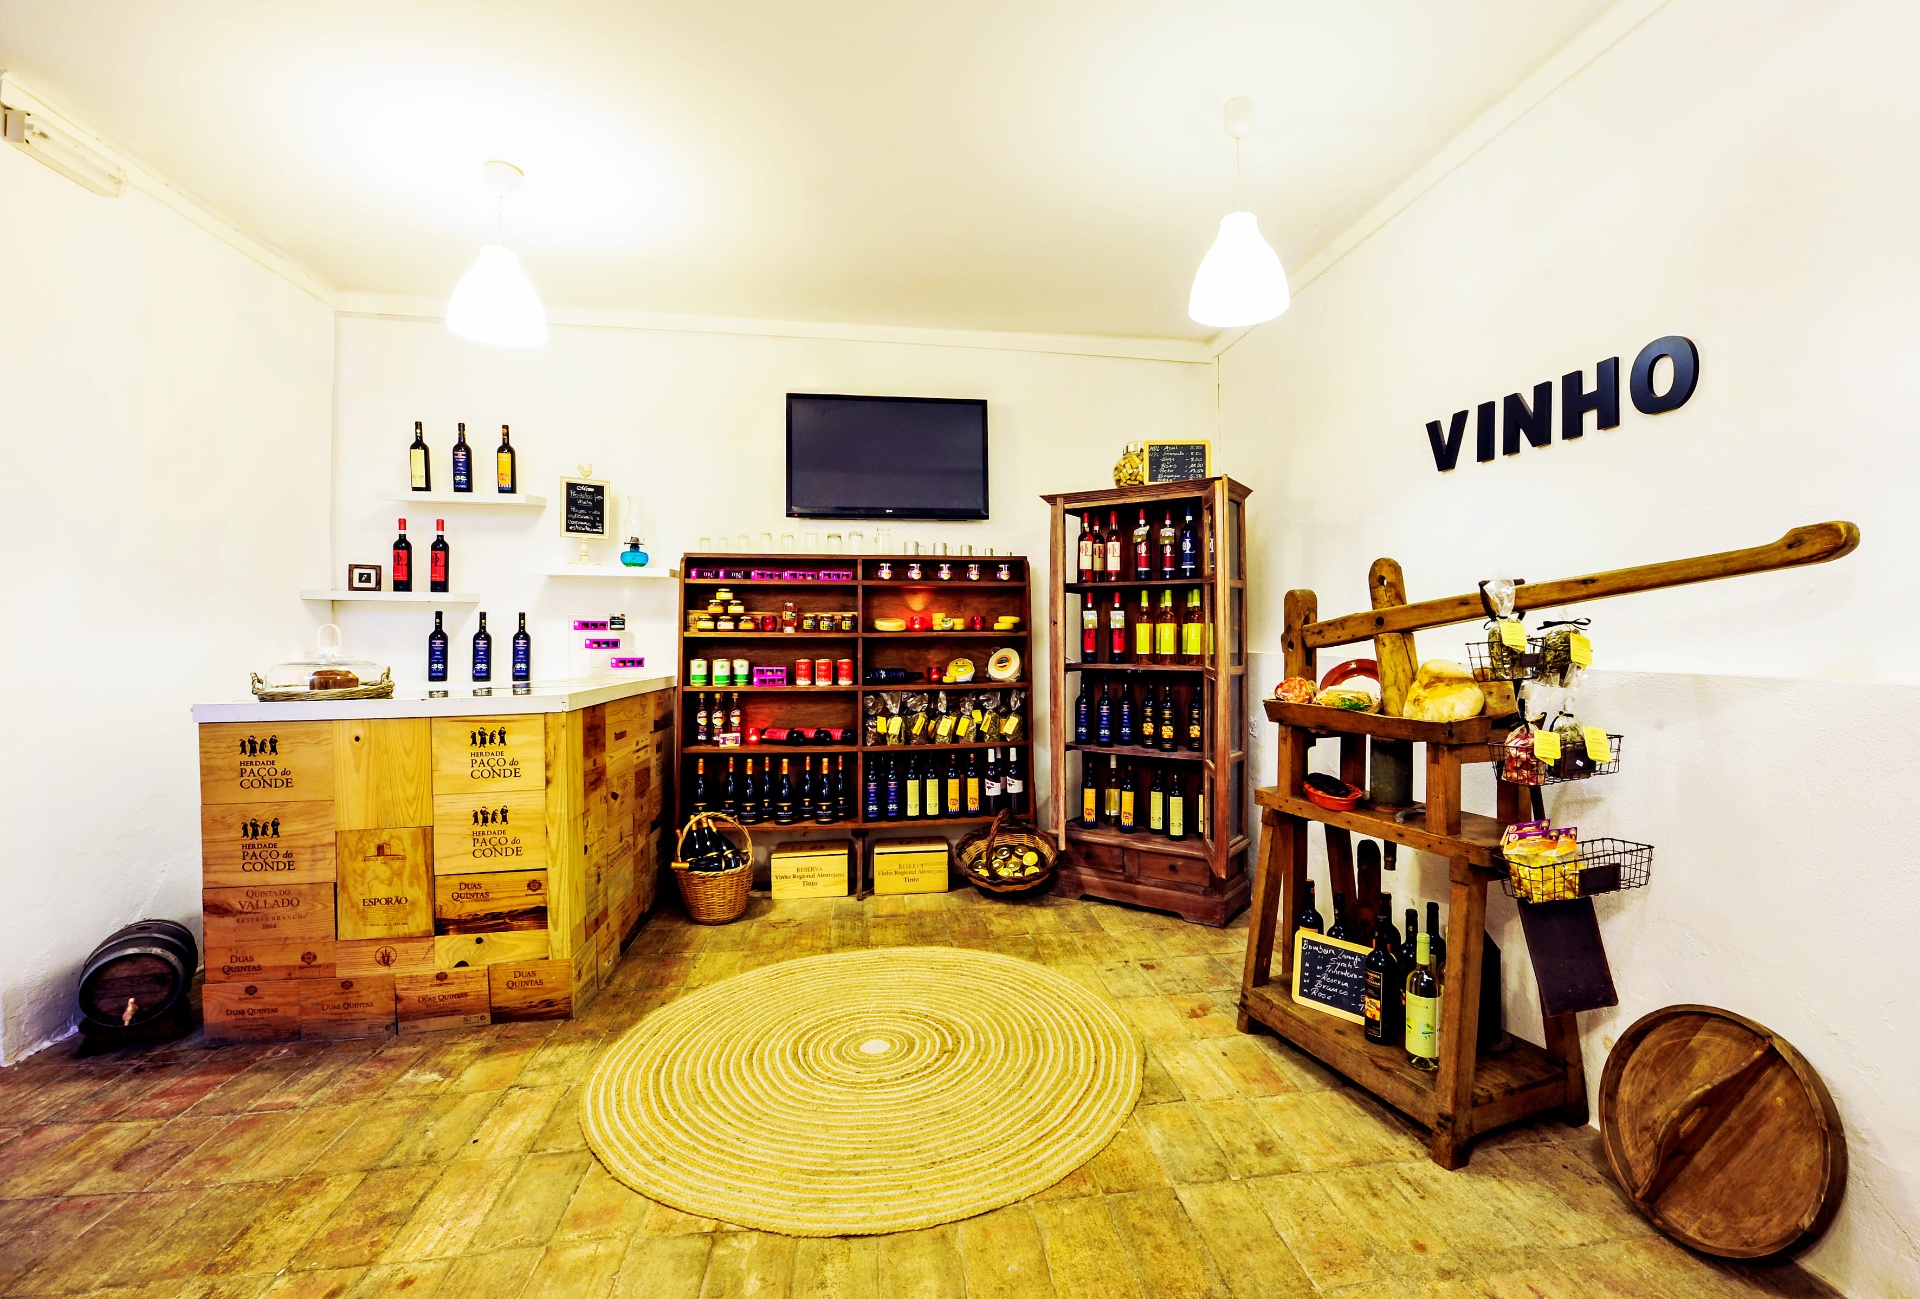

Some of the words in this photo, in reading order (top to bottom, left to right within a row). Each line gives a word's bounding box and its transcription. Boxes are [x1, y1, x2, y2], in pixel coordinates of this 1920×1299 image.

[1425, 335, 1700, 472] VINHO
[470, 758, 506, 770] PAÇO
[509, 758, 519, 767] do
[239, 767, 278, 780] PAÇO
[280, 768, 291, 776] do
[470, 768, 522, 779] CONDE
[239, 778, 294, 789] CONDE
[472, 836, 508, 849] PAÇO
[510, 837, 521, 845] do
[241, 850, 280, 862] PAÇO
[282, 850, 293, 859] do
[472, 846, 524, 858] CONDE
[241, 860, 296, 872] CONDE
[459, 882, 482, 891] DUAS
[246, 890, 278, 899] QUINTA
[451, 892, 490, 902] QUINTAS
[238, 897, 300, 910] VALLADO
[362, 896, 408, 907] ESPORÃO
[230, 955, 254, 964] DUAS
[1329, 957, 1353, 971] Syrah
[221, 964, 262, 975] QUINTAS
[513, 970, 537, 979] DUAS
[506, 979, 544, 990] QUINTAS
[1321, 973, 1349, 988] Reserva
[1314, 980, 1349, 996] Branco
[417, 996, 436, 1004] DUAS
[437, 992, 469, 1002] QUINTAS
[225, 1008, 246, 1016] DUAS
[246, 1007, 279, 1016] QUINTAS
[322, 1003, 341, 1011] DUAS
[342, 1002, 374, 1010] QUINTAS
